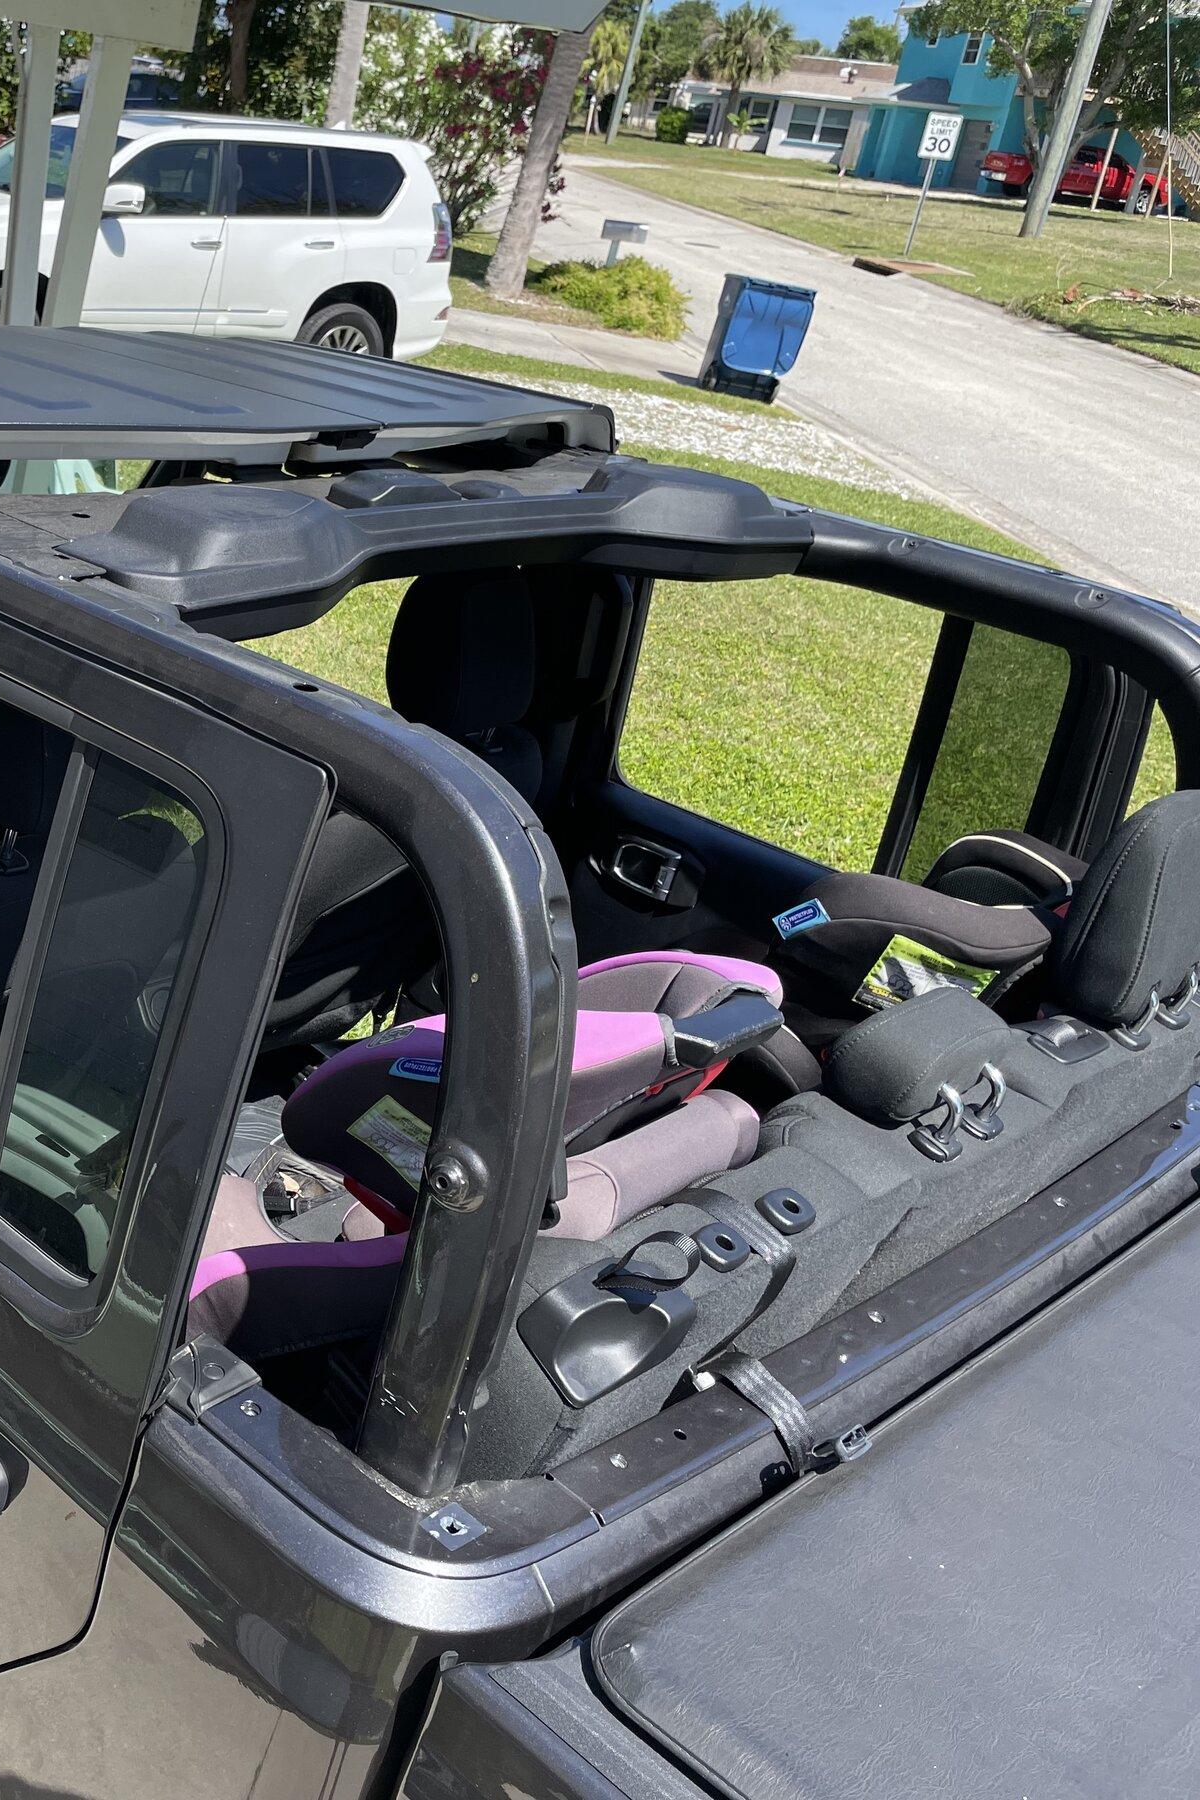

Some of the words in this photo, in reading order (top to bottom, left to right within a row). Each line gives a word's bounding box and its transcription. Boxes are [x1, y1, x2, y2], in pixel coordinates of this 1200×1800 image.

[930, 118, 958, 128] SPEED
[930, 128, 953, 136] LIMIT
[925, 136, 951, 153] 30
